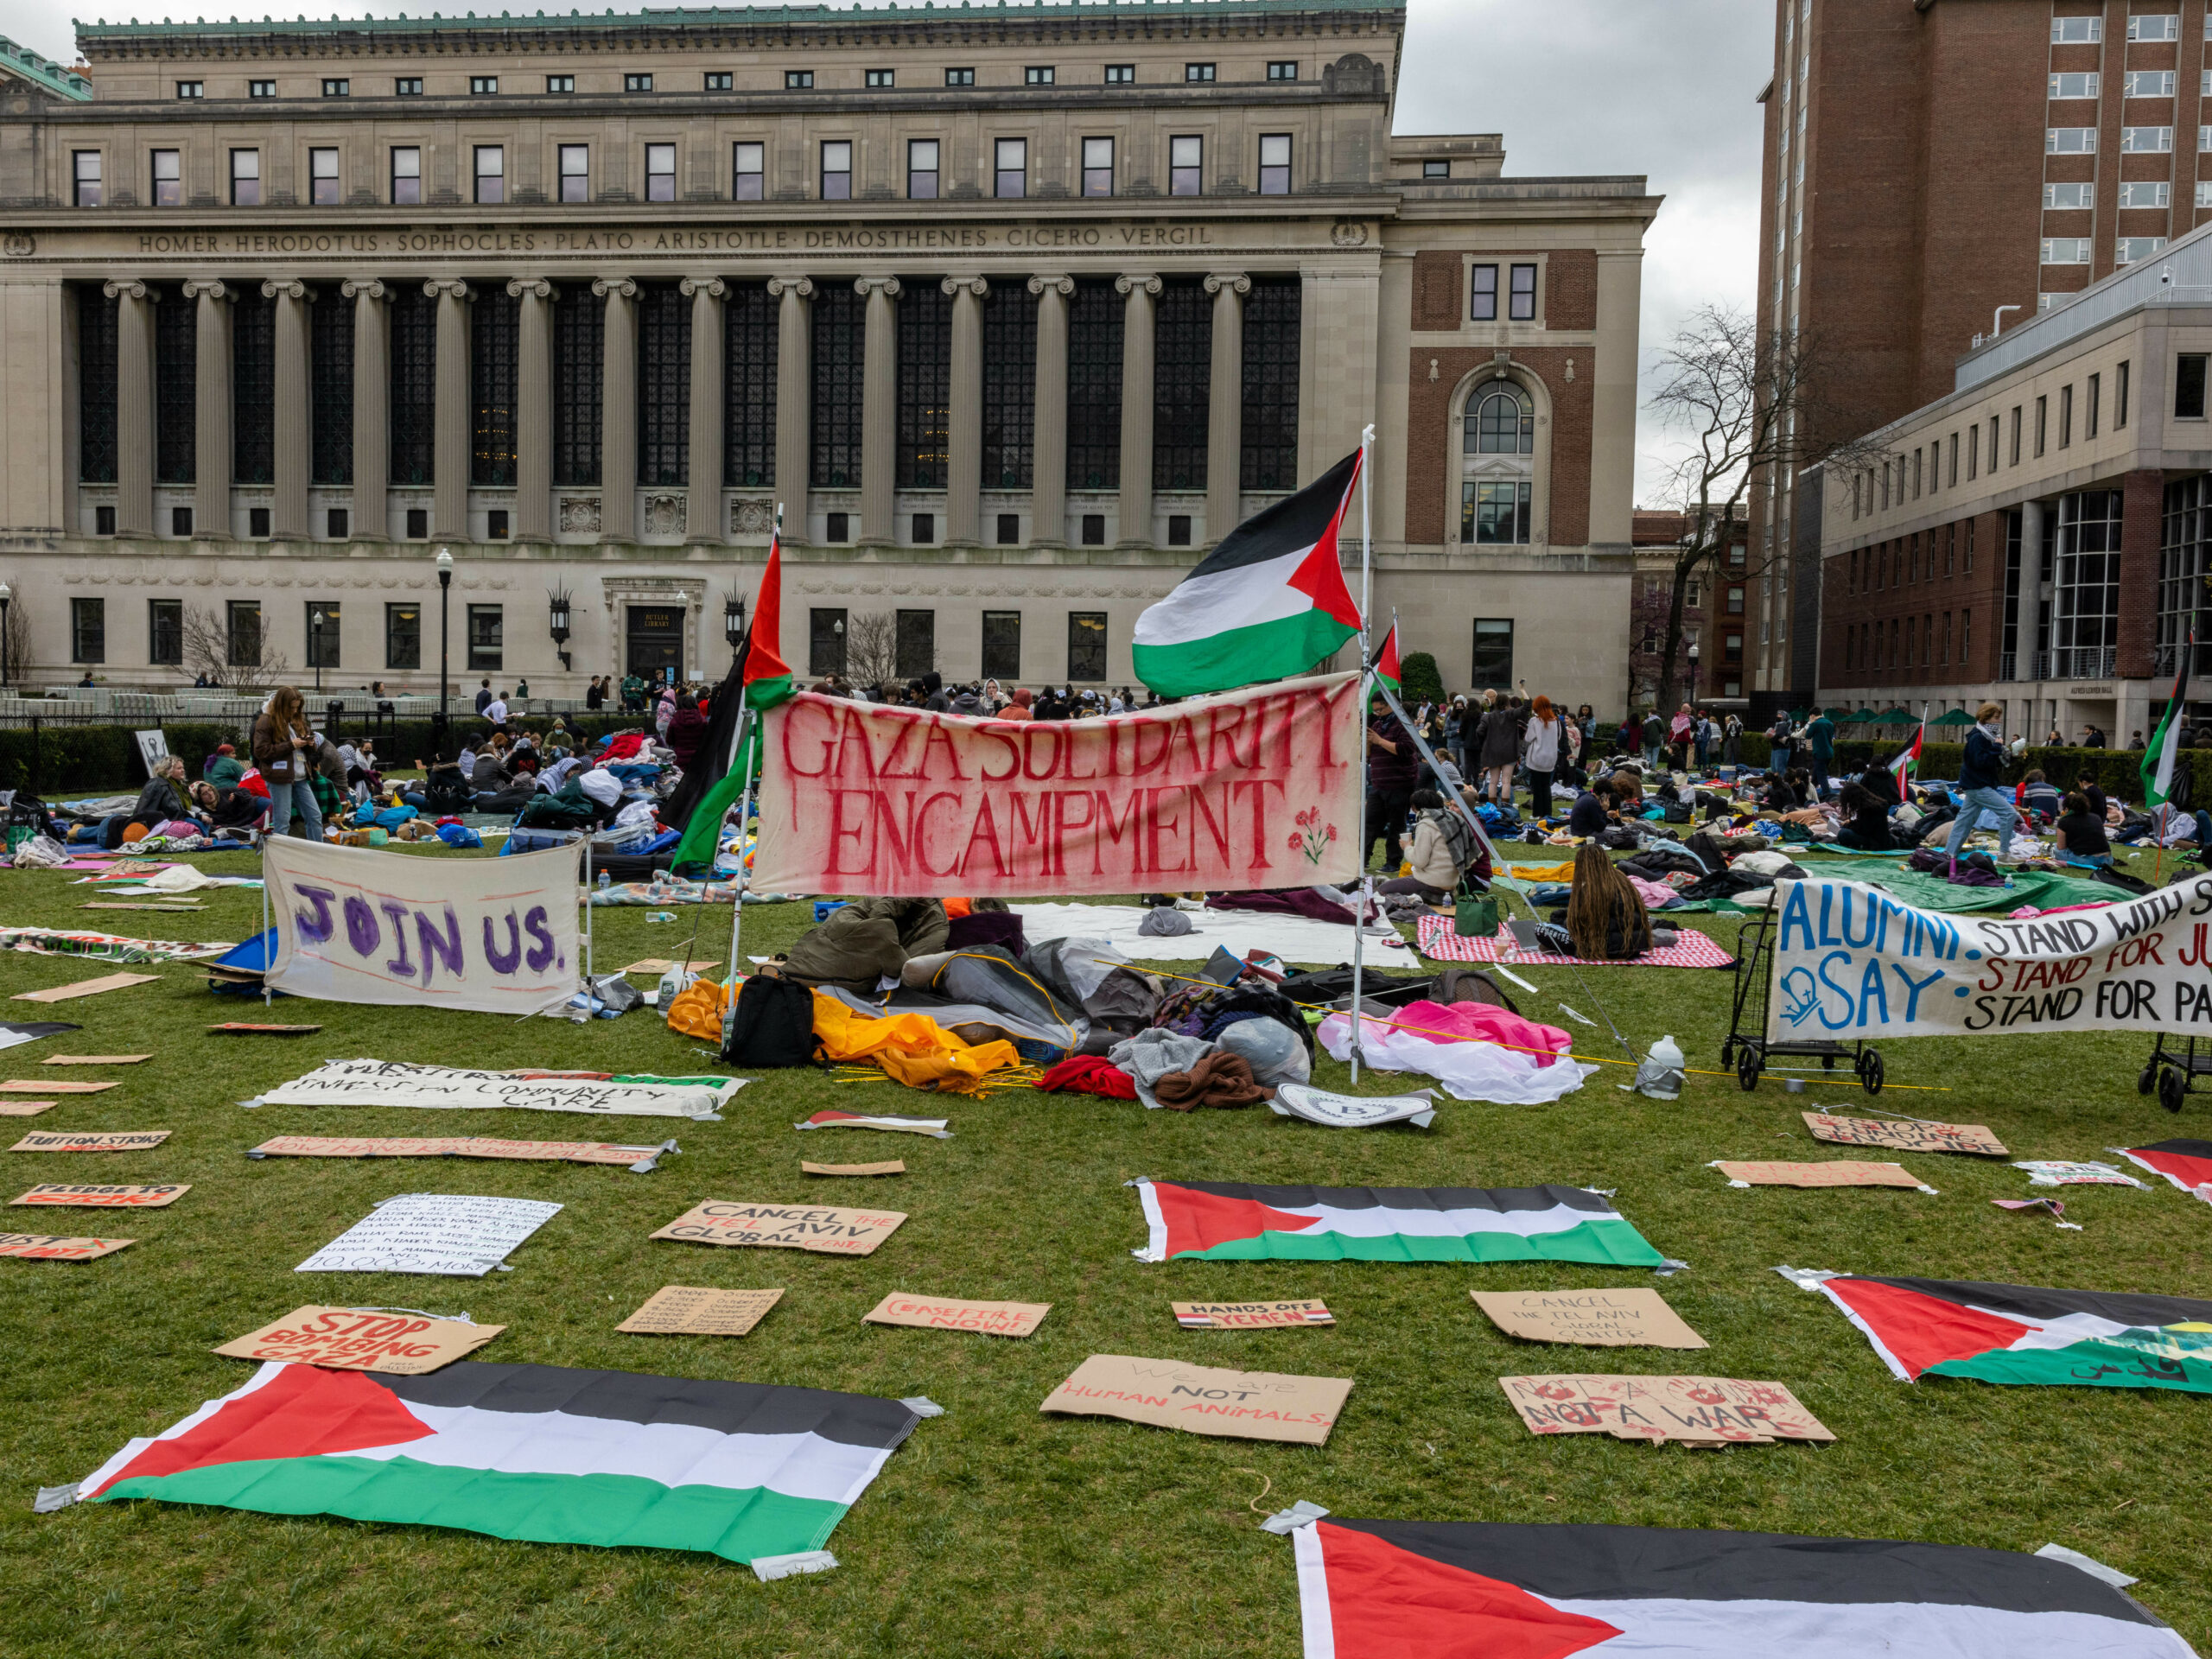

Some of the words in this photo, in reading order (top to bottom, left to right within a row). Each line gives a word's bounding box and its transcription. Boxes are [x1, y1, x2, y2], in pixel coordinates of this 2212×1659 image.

[139, 234, 219, 252] HOMER
[236, 234, 378, 251] HERODOTUS
[397, 232, 536, 251] SOPHOCLES
[556, 232, 633, 250] PLATO
[654, 229, 787, 249] ARISTOTLE
[804, 229, 987, 247] DEMOSTHENES
[1007, 228, 1101, 246] CICERO
[1119, 226, 1213, 246] VERGIL
[783, 698, 967, 781] GAZA
[978, 689, 1351, 780] SOLIDARITY
[822, 779, 1286, 878] ENCAMPMENT
[294, 883, 465, 984] JOIN
[482, 906, 565, 977] US.
[1978, 918, 2099, 957] STAND
[2106, 890, 2183, 942] WITH
[1978, 957, 2093, 993] STAND
[2105, 932, 2165, 973] FOR
[1964, 987, 2083, 1031] STAND
[2094, 979, 2162, 1022] FOR
[476, 1084, 668, 1100] COMMUNITY
[503, 1094, 610, 1109] CARE
[1849, 1117, 1934, 1132] STOP
[25, 1135, 99, 1145] TUITION
[262, 1141, 326, 1151] HOW
[328, 1144, 415, 1153] MANY
[1810, 1128, 2005, 1153] GENOCIDE
[1725, 1163, 1840, 1172] CANCEL
[25, 1192, 170, 1205] STRIKE
[33, 1185, 130, 1194] PLEDGE
[702, 1205, 842, 1224] CANCEL
[854, 1214, 896, 1228] THE
[703, 1215, 762, 1230] TEL
[779, 1222, 874, 1238] AVIV
[669, 1225, 802, 1243] GLOBAL
[804, 1237, 880, 1251] CENTER
[886, 1299, 1034, 1323] CEASEFIRE
[1190, 1303, 1270, 1314] HANDS
[1274, 1302, 1313, 1313] OFF
[1521, 1296, 1626, 1309] CANCEL
[928, 1317, 1021, 1332] NOW!
[1208, 1311, 1306, 1325] YEMEN
[1507, 1311, 1542, 1319] THE
[1549, 1311, 1590, 1320] TEL
[1596, 1310, 1642, 1320] AVIV
[1549, 1320, 1632, 1330] GLOBAL
[302, 1312, 432, 1342] STOP
[1558, 1329, 1647, 1339] CENTER
[258, 1329, 441, 1358] BOMBING
[252, 1344, 380, 1368] GAZA
[1131, 1363, 1196, 1382] We
[1236, 1382, 1298, 1393] are
[1510, 1378, 1592, 1400] NOT
[1626, 1381, 1659, 1401] A
[1170, 1384, 1260, 1402] NOT
[1523, 1402, 1603, 1426] NOT
[1619, 1403, 1655, 1425] A
[1660, 1404, 1784, 1431] WAR
